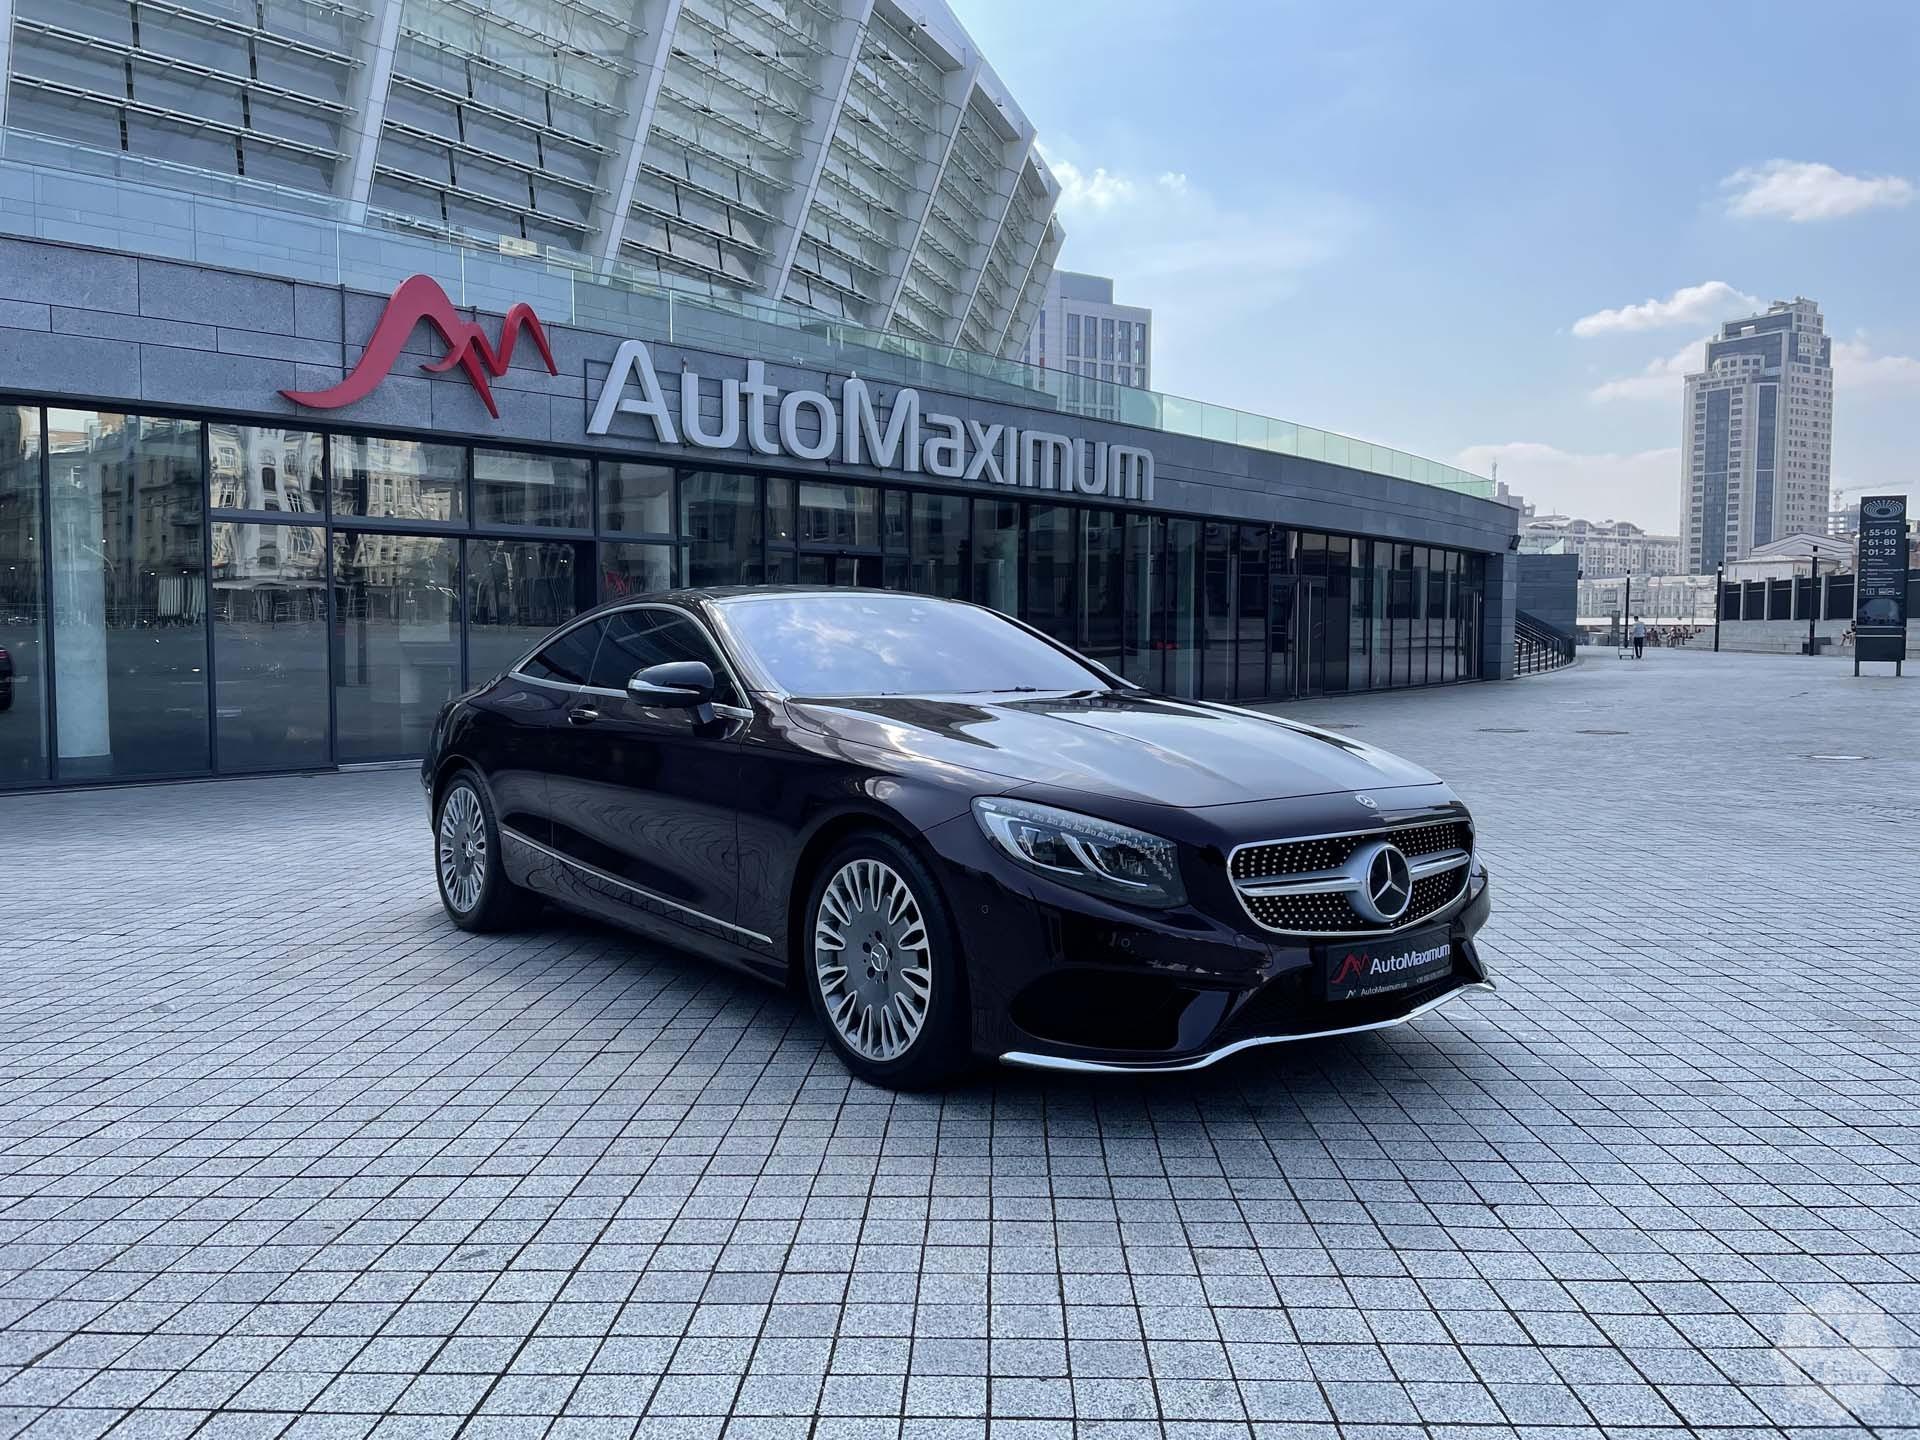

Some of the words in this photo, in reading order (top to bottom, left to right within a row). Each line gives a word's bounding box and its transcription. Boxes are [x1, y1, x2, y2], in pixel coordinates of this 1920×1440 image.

[586, 339, 1155, 501] AutoMaximum
[1869, 528, 1897, 536] 55-60
[1868, 538, 1897, 546] 61-80
[1867, 548, 1897, 556] 01-22
[1369, 943, 1450, 975] AutoMaximum
